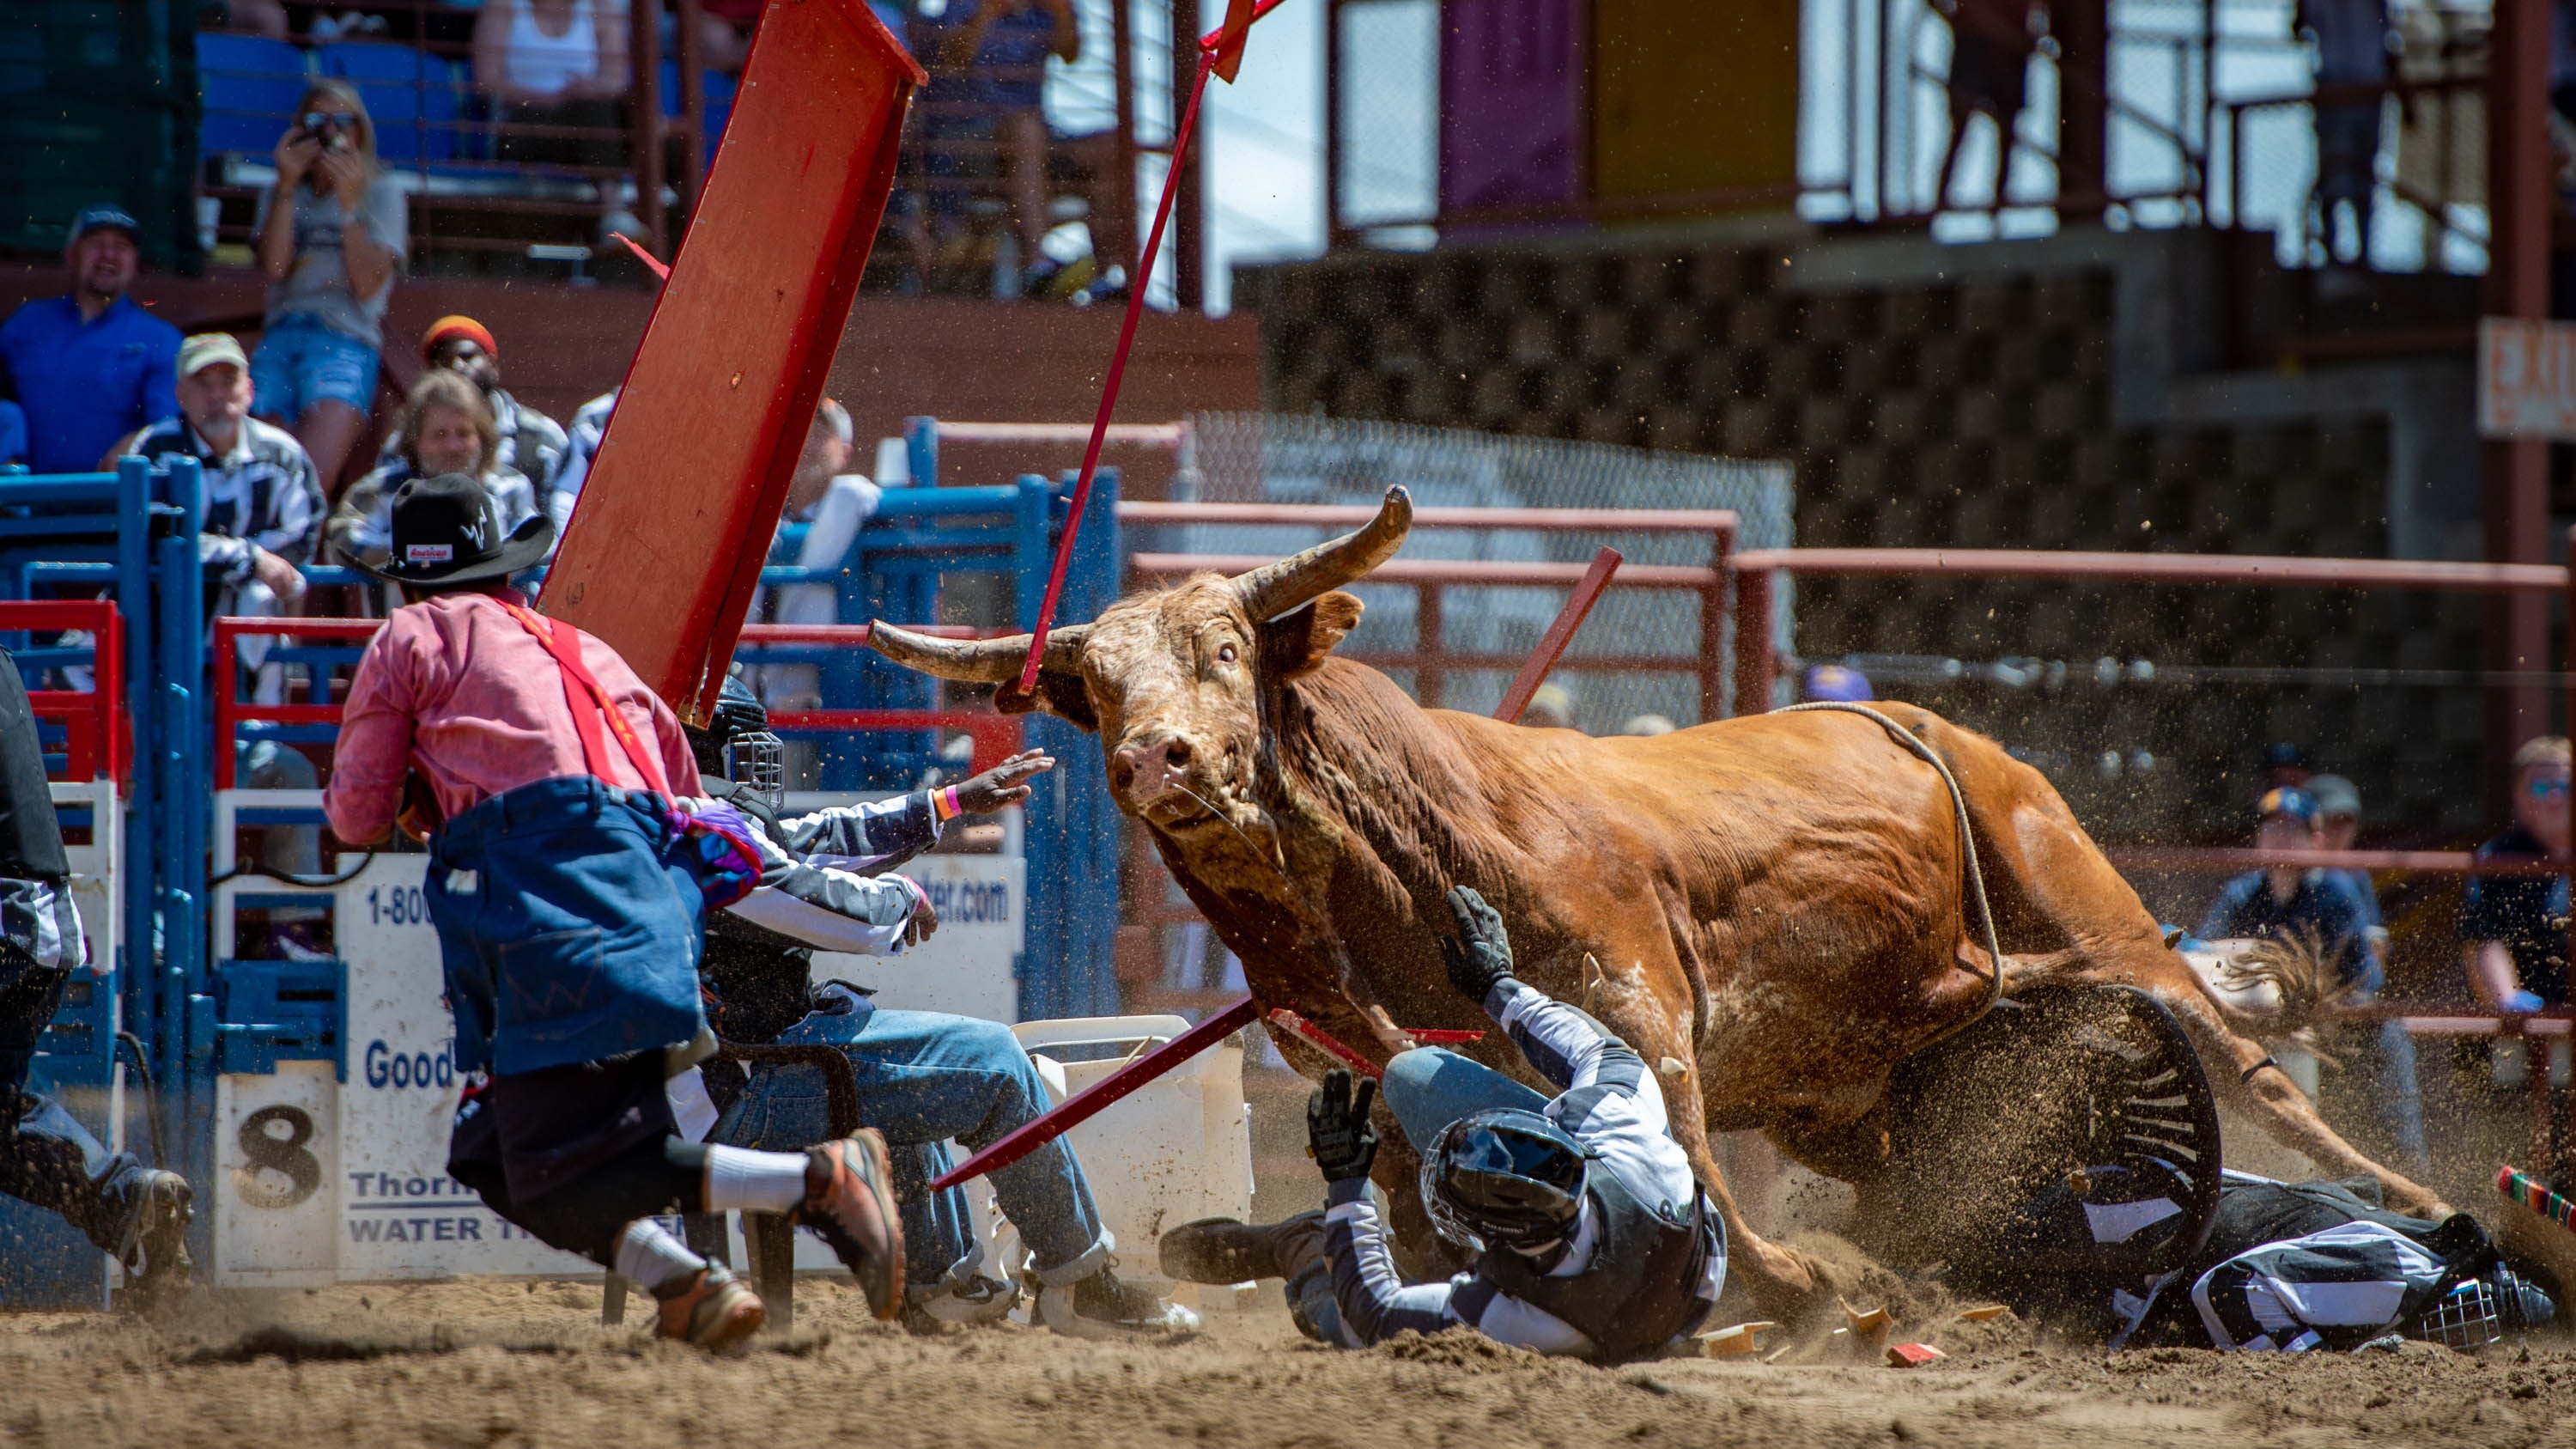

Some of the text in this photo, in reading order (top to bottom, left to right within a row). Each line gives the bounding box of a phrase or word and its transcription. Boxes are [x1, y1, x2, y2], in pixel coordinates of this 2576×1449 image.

[368, 886, 433, 925] 1-80
[367, 1038, 453, 1089] Good
[239, 1105, 321, 1209] 8
[349, 1216, 483, 1242] WATER
